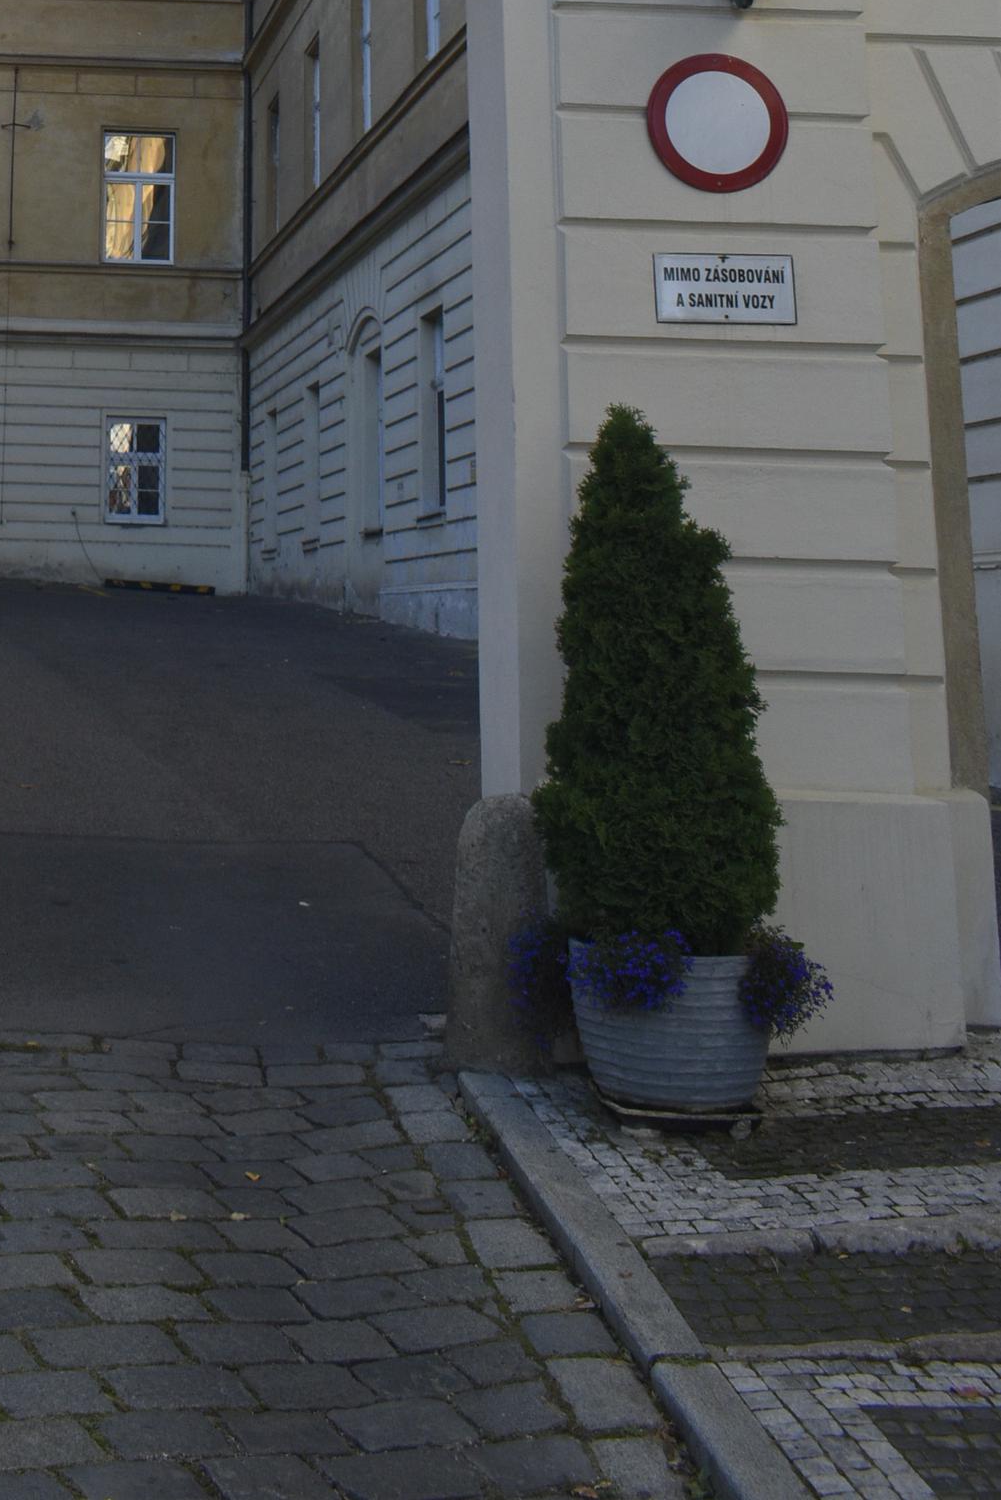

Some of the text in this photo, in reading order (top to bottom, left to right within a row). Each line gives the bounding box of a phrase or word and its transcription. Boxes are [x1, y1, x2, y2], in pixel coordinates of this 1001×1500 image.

[663, 264, 785, 284] MIMO ZÁSOBOVÁNÍ
[676, 290, 776, 309] A SANITNÍ VOZY
